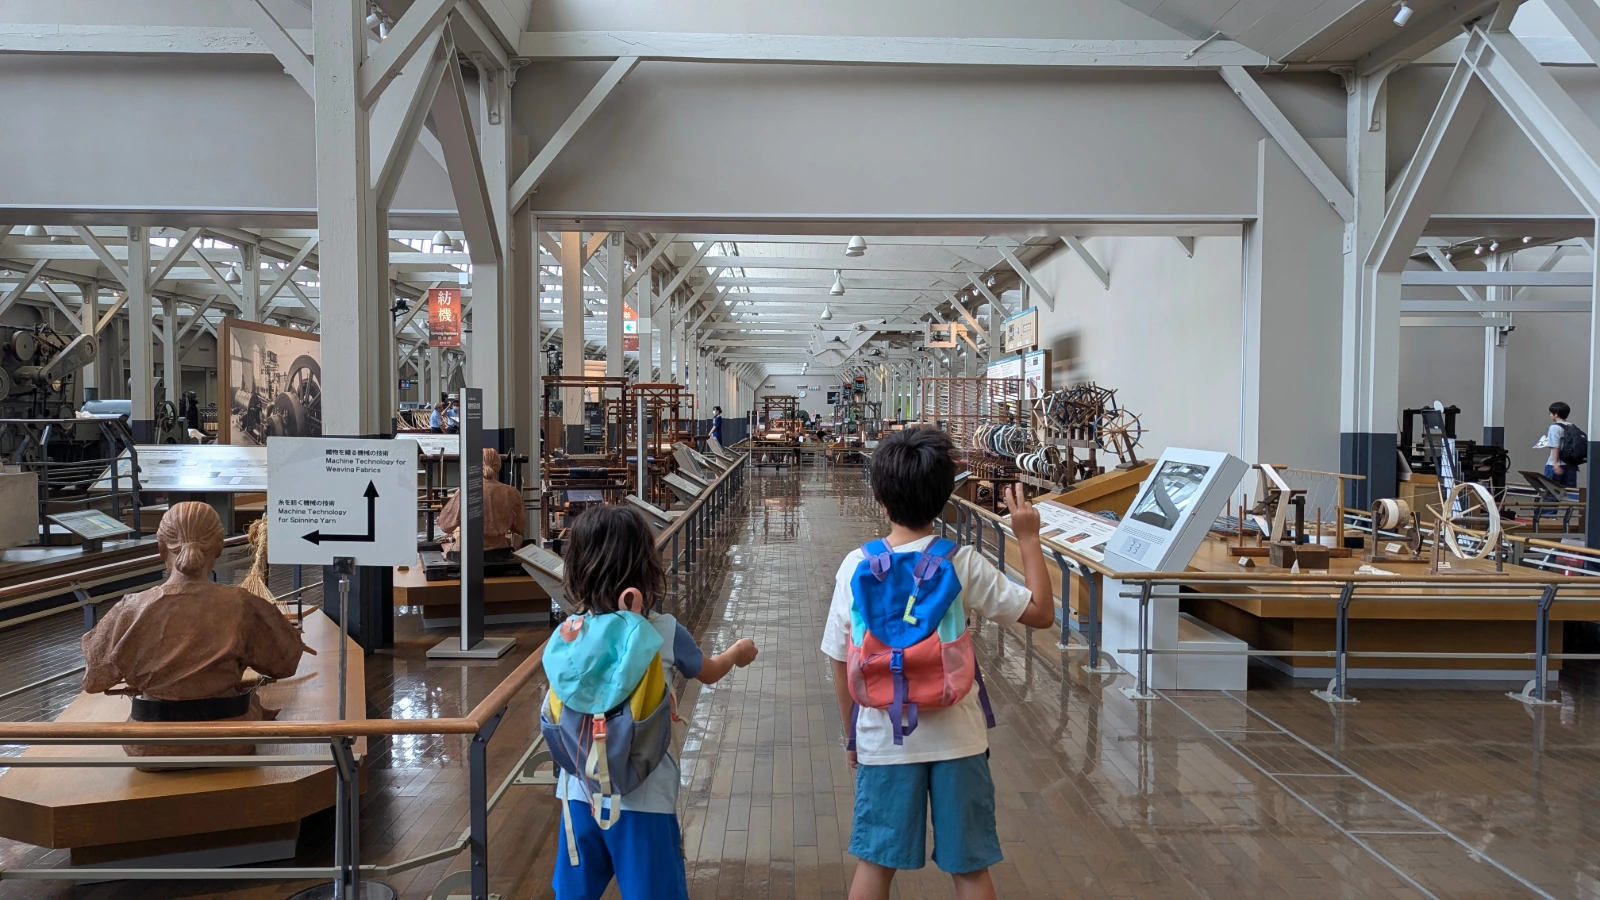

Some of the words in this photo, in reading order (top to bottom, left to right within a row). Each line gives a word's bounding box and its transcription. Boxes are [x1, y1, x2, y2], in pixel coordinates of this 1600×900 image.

[437, 291, 452, 322] 紡機
[278, 499, 335, 507] 糸を紡ぐ機械の技術
